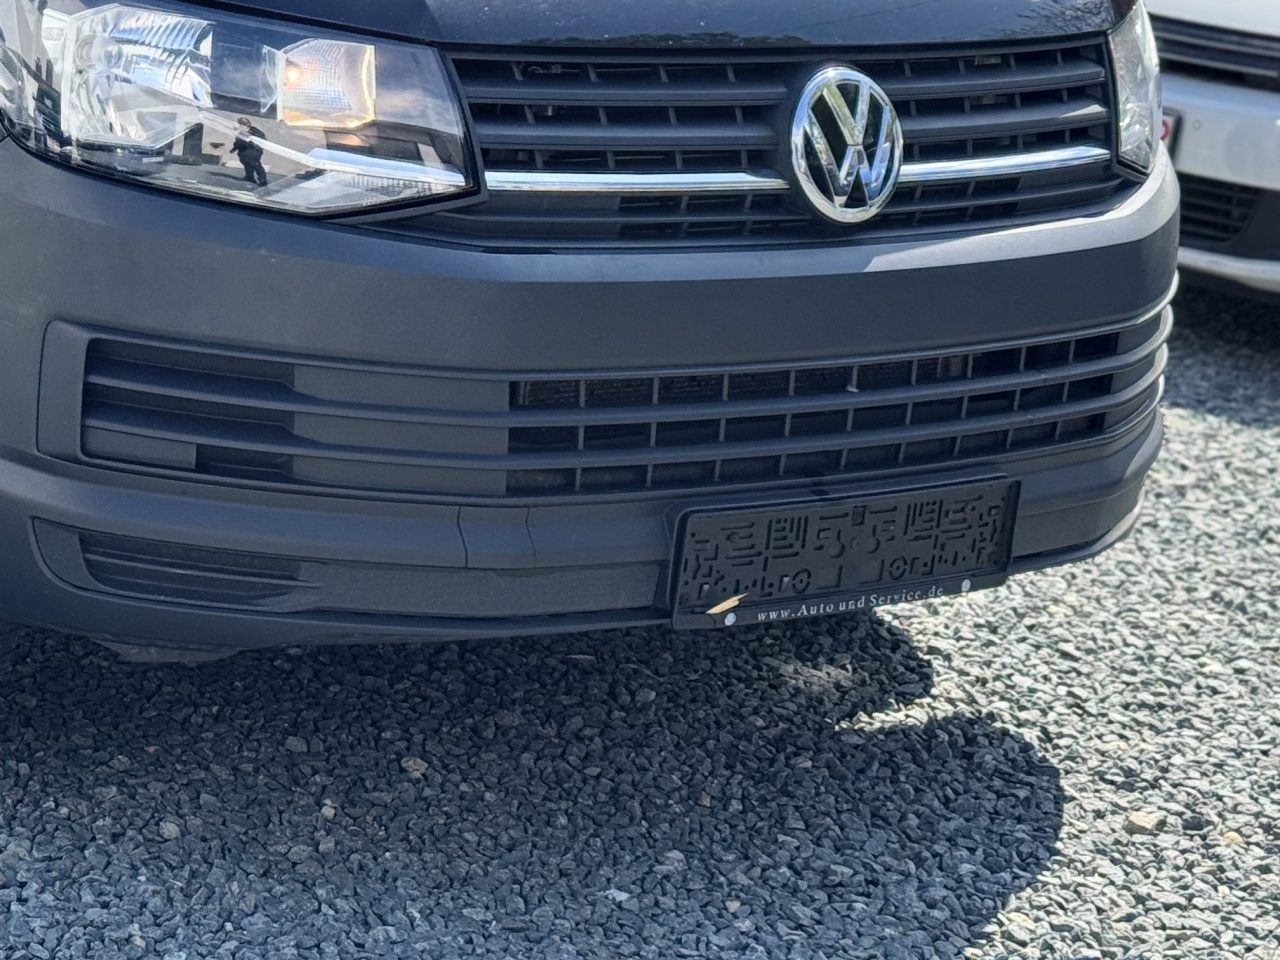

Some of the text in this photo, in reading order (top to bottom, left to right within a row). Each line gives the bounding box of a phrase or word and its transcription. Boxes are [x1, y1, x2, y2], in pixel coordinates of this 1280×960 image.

[757, 585, 944, 622] www.Auto und Service.de
